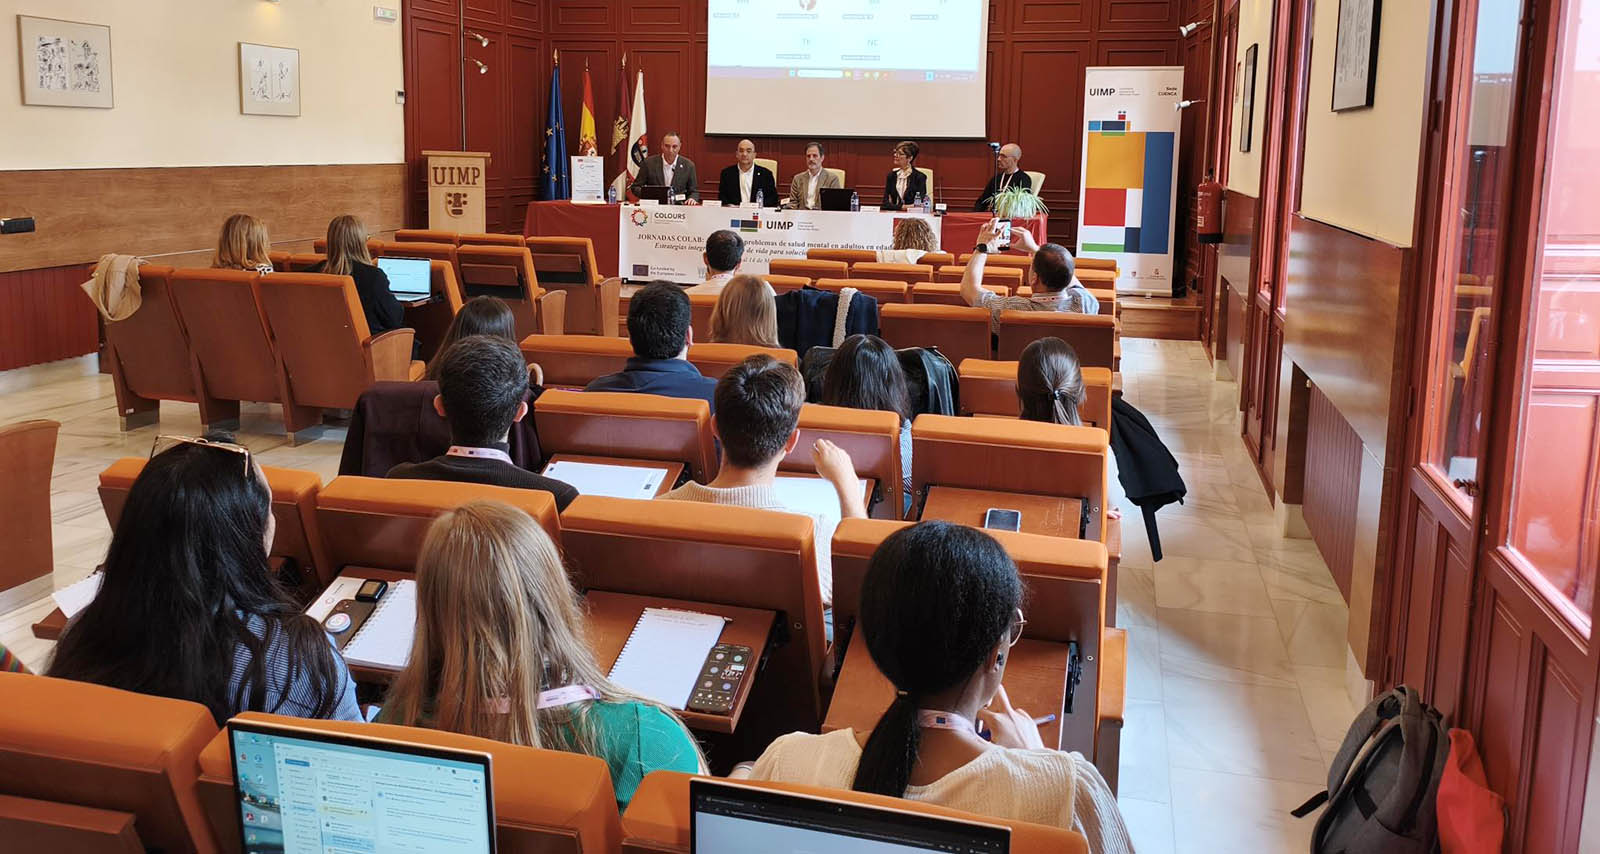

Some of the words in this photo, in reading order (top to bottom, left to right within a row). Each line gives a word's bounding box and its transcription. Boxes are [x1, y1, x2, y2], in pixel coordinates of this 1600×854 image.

[1089, 88, 1116, 97] UIMP
[432, 166, 480, 185] UIMP
[766, 220, 794, 230] UIMP
[654, 242, 687, 251] Estrategias
[688, 244, 706, 252] integr
[676, 235, 705, 243] COLAB:
[744, 239, 778, 247] problemas
[840, 242, 865, 250] adultos
